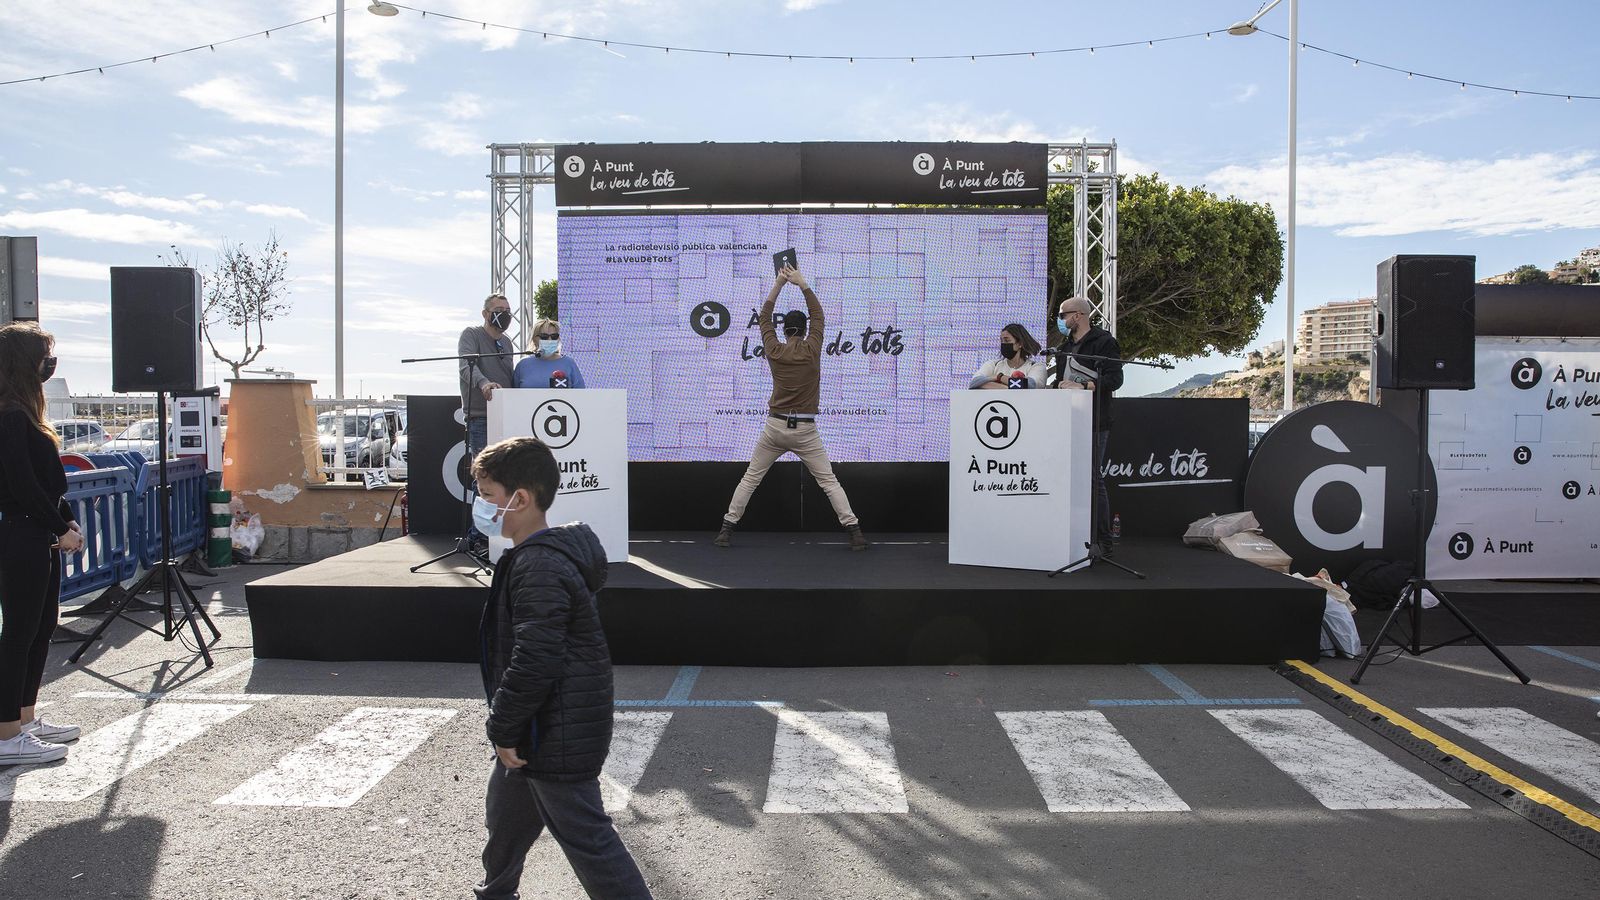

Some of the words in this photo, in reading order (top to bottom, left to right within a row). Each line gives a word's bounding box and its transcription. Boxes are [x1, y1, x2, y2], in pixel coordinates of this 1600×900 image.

[593, 160, 602, 172] À
[606, 162, 634, 172] Punt
[943, 157, 952, 170] À
[956, 160, 984, 171] Punt
[590, 175, 607, 191] La
[609, 177, 631, 189] veu
[634, 172, 650, 187] de
[652, 169, 676, 187] tots
[940, 174, 957, 189] La
[959, 175, 981, 188] veu
[984, 171, 1000, 187] de
[1002, 169, 1025, 187] tots
[617, 243, 680, 251] radiotelevisió
[682, 243, 716, 253] pública
[718, 243, 768, 251] valenciana
[826, 331, 855, 356] de
[860, 325, 905, 356] tots
[1517, 361, 1535, 383] à
[1552, 364, 1567, 383] À
[1546, 388, 1570, 411] La
[543, 405, 568, 437] à
[985, 406, 1009, 438] à
[558, 458, 587, 473] unt
[968, 454, 981, 474] À
[987, 459, 1027, 475] Punt
[1100, 459, 1134, 478] veu
[1140, 452, 1165, 477] de
[1169, 448, 1209, 478] tots
[567, 476, 579, 490] de
[581, 473, 599, 488] tots
[973, 479, 986, 492] La
[988, 481, 1004, 491] veu
[1006, 479, 1019, 491] de
[1020, 477, 1039, 492] tots
[1293, 424, 1387, 551] à
[1587, 484, 1596, 496] À
[1454, 535, 1468, 554] à
[1483, 537, 1495, 553] À
[1499, 539, 1534, 553] Punt
